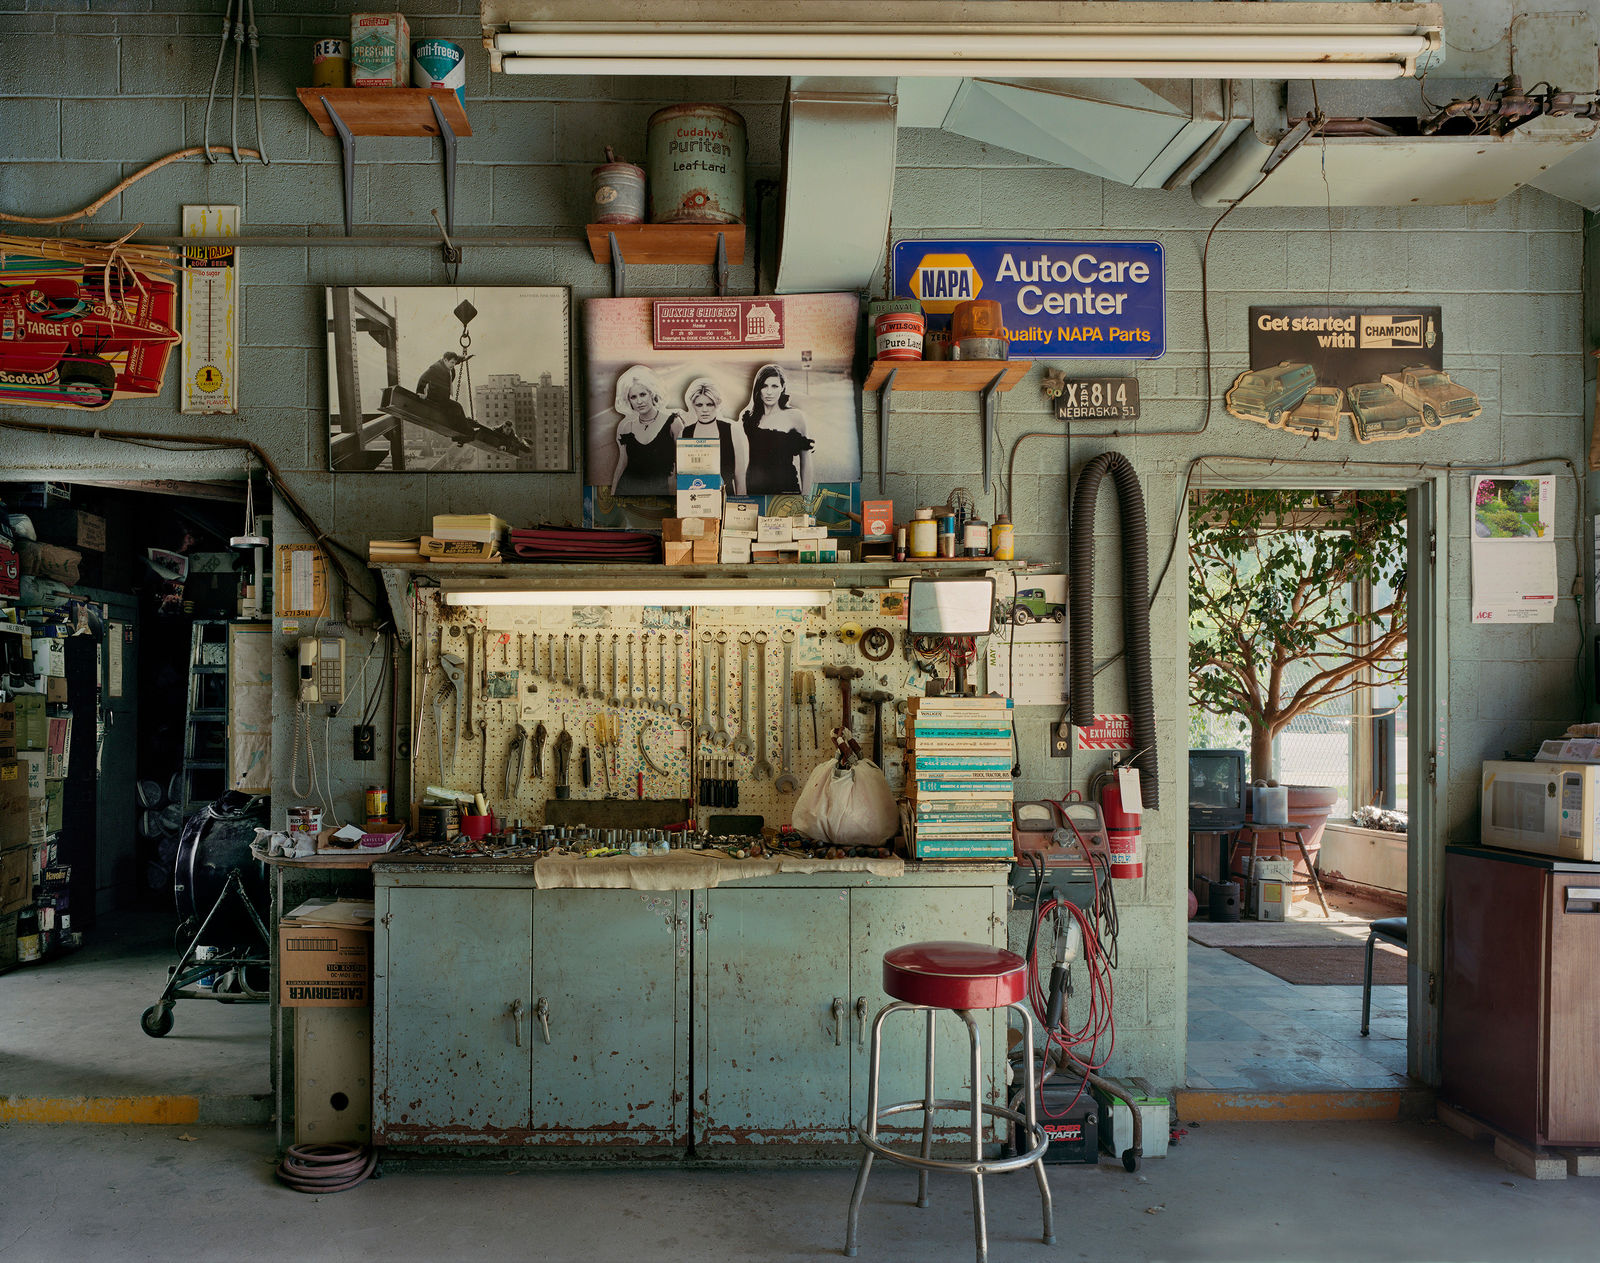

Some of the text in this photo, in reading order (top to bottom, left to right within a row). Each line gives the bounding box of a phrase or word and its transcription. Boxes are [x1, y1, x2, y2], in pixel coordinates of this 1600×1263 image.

[354, 46, 394, 58] PRESTONE
[416, 43, 460, 61] anti-freeze
[677, 128, 724, 140] Cudahy's
[673, 160, 726, 173] Leaf Lard
[996, 253, 1149, 283] AutoCare
[922, 269, 971, 298] NAPA
[1016, 285, 1128, 316] Center
[662, 307, 738, 318] DIXIE CHICKS
[889, 304, 912, 312] LAVAL
[27, 321, 70, 336] TARGET
[1258, 315, 1356, 332] Get started
[1057, 327, 1104, 342] NAPA
[1109, 327, 1151, 342] Parts
[1365, 325, 1418, 338] CHAMPION
[885, 338, 906, 348] Pure
[1318, 333, 1356, 348] with
[0, 370, 46, 385] Scotch
[206, 370, 212, 382] 1
[1066, 383, 1078, 408] X
[1091, 383, 1128, 406] 814
[1060, 406, 1136, 418] NEBRASKA 51
[1105, 720, 1130, 729] FIRE
[290, 987, 331, 1000] DRIVER
